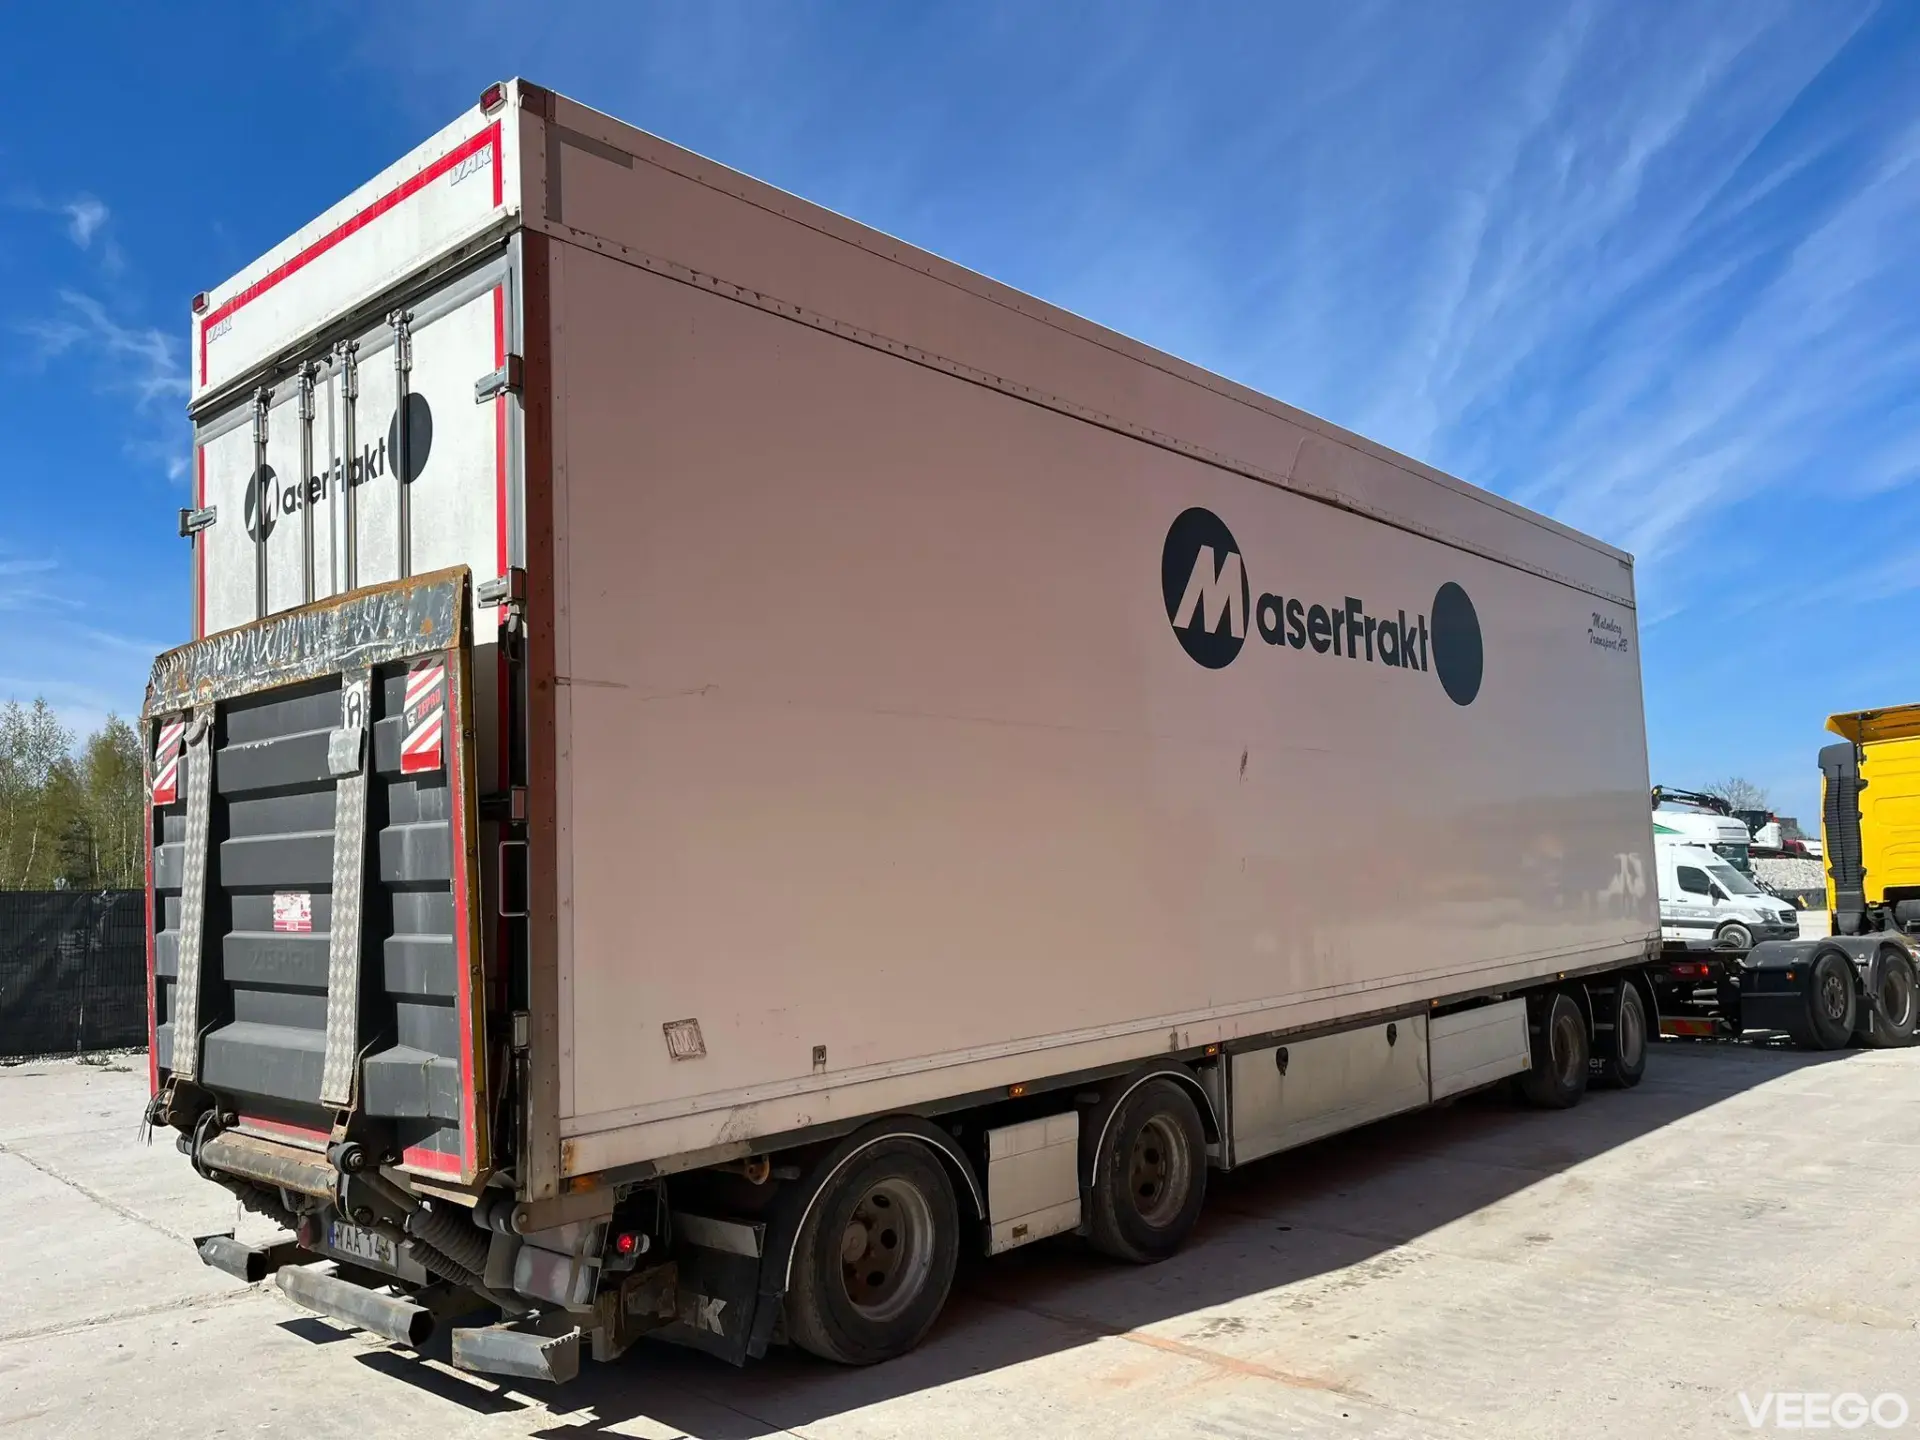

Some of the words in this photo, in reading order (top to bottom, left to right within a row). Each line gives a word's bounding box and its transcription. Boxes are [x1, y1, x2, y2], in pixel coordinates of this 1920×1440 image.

[450, 143, 492, 187] VAK
[1172, 544, 1429, 673] MaserFrakt
[1587, 628, 1617, 652] Transport
